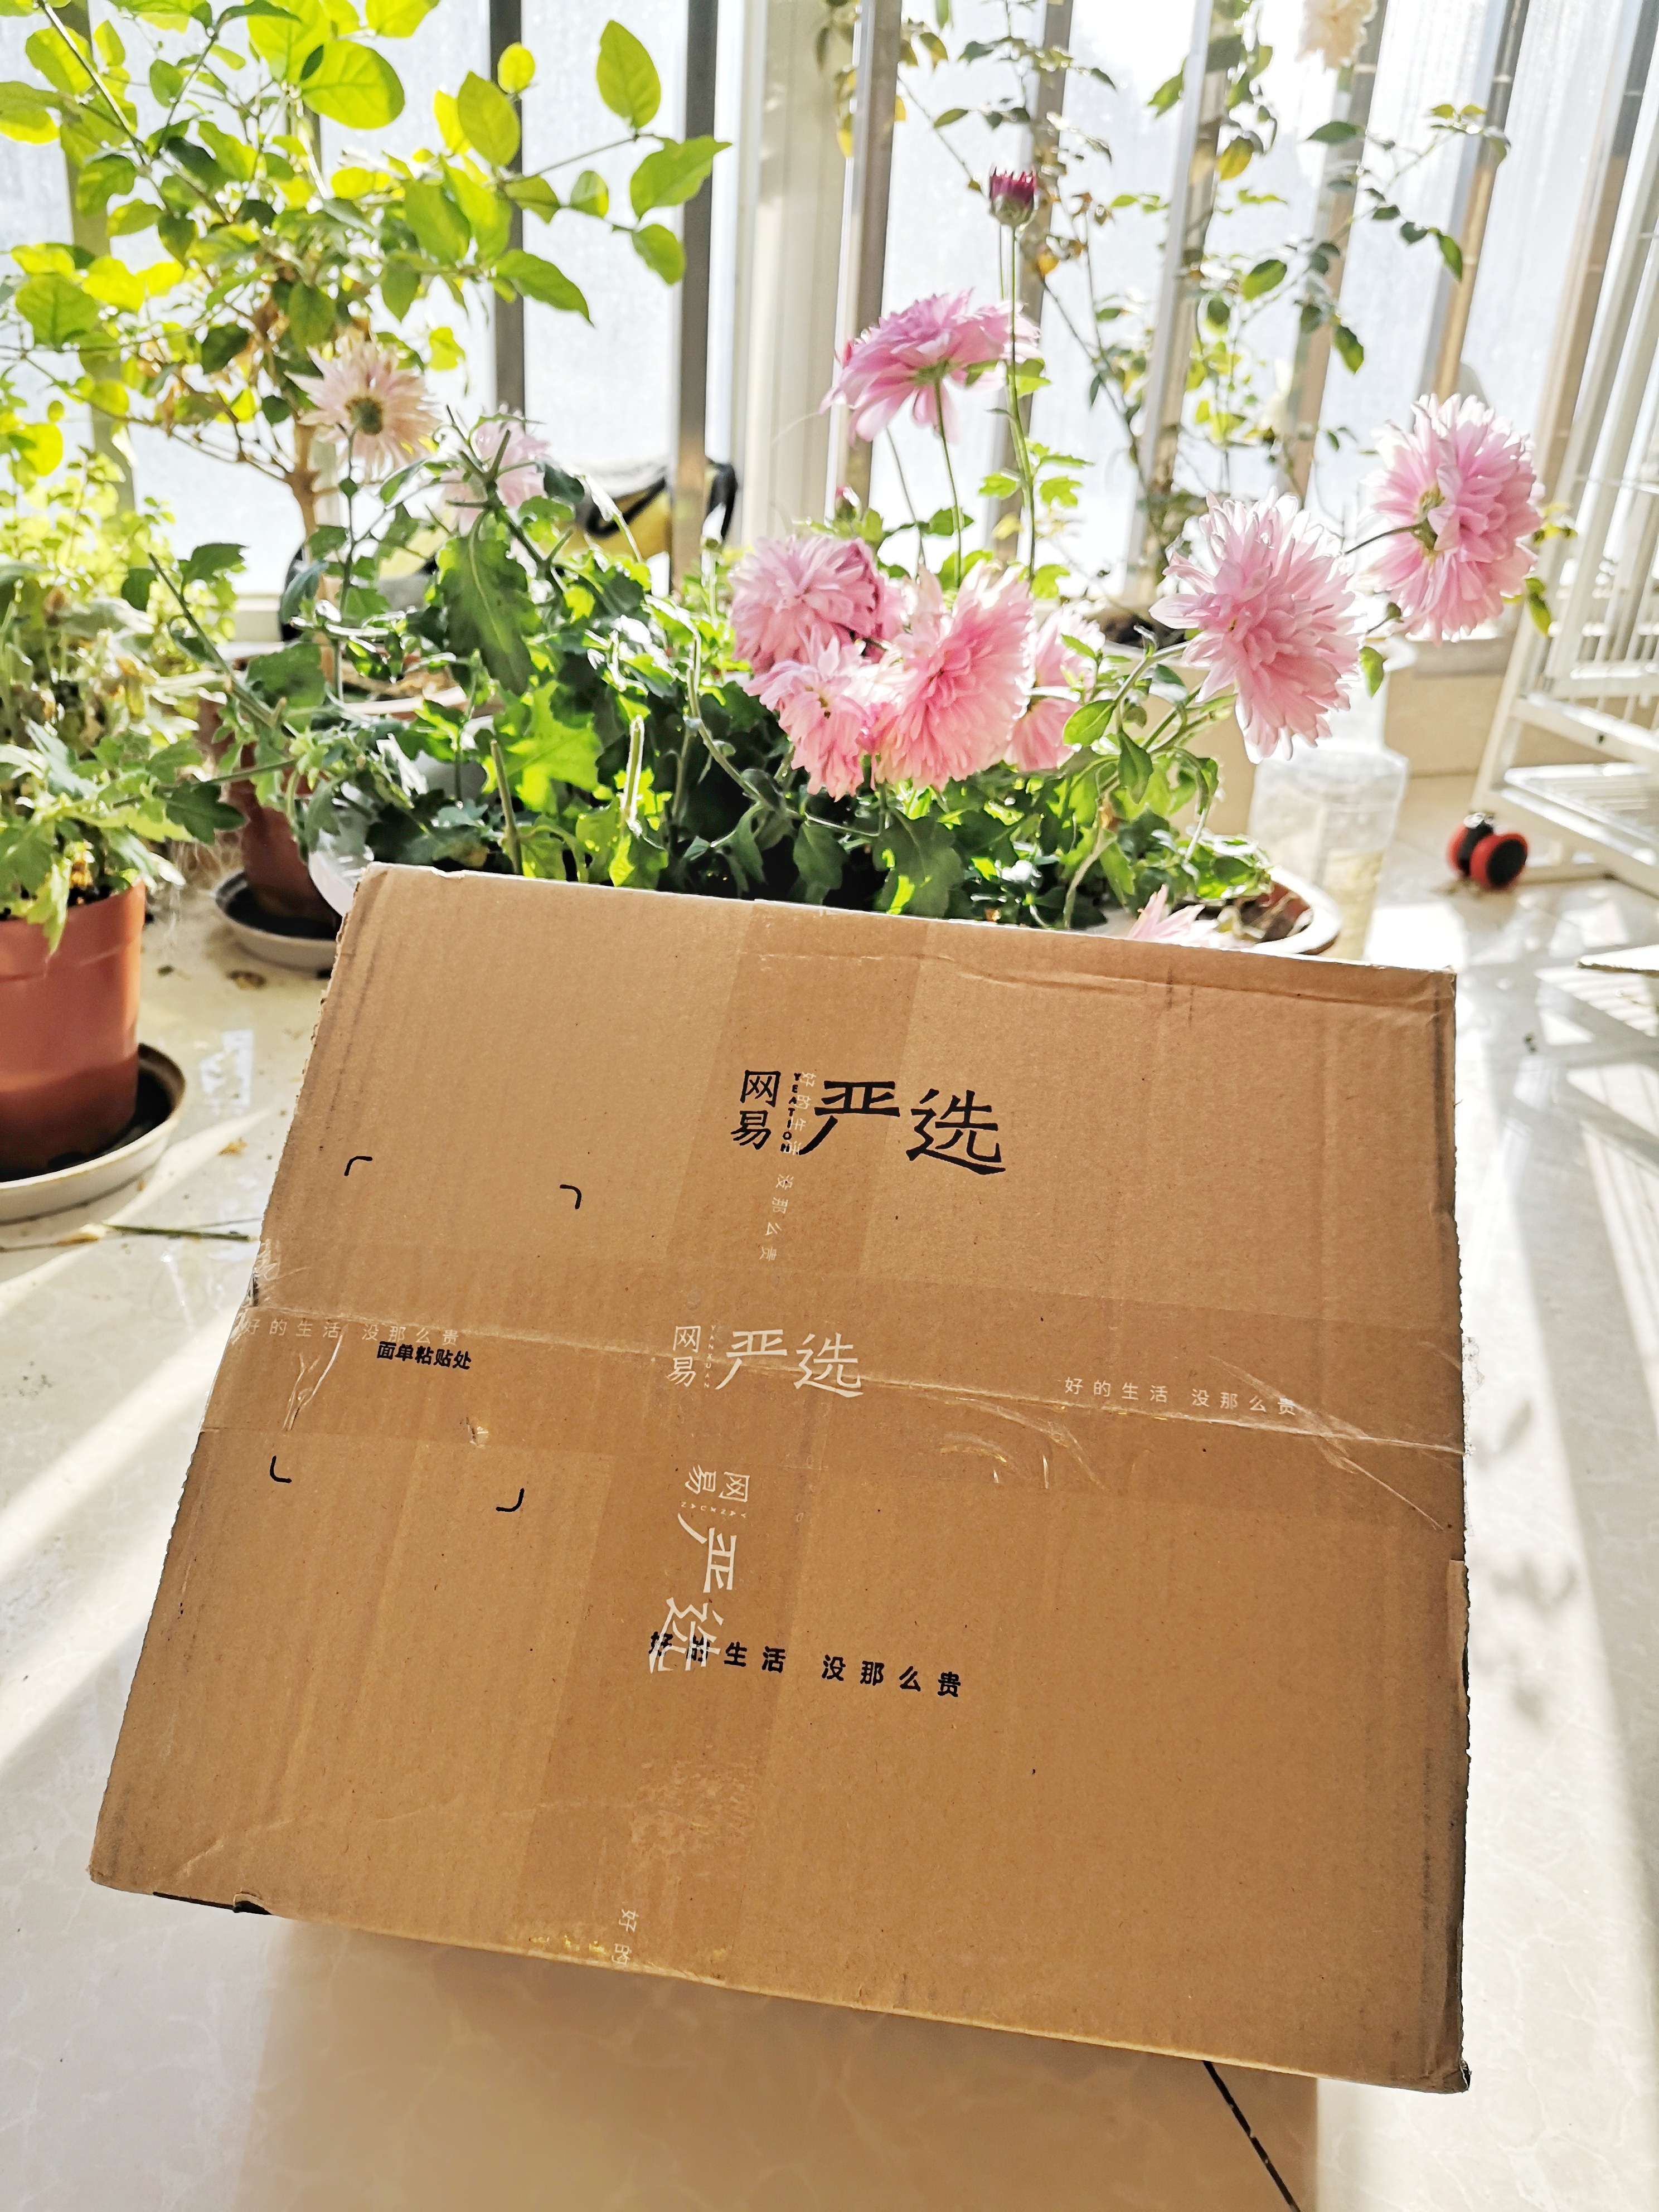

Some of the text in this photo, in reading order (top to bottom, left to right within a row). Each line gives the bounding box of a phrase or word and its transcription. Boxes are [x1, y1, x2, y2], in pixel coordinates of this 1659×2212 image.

[730, 1070, 782, 1150] 网易
[798, 1080, 1006, 1175] 严选
[759, 1173, 794, 1262] 没那么贵
[244, 1318, 460, 1346] 好的生活 没那么贵
[376, 1340, 472, 1370] 面单粘贴处
[665, 1325, 701, 1388] 网易
[704, 1325, 716, 1388] YANXUAN
[715, 1328, 864, 1398] 严选
[1064, 1376, 1297, 1417] 好的生活 没那么贵
[685, 1464, 750, 1503] 网易
[648, 1512, 737, 1674] 严选
[821, 1654, 962, 1697] 没那么贵
[612, 1908, 639, 1966] 好的
